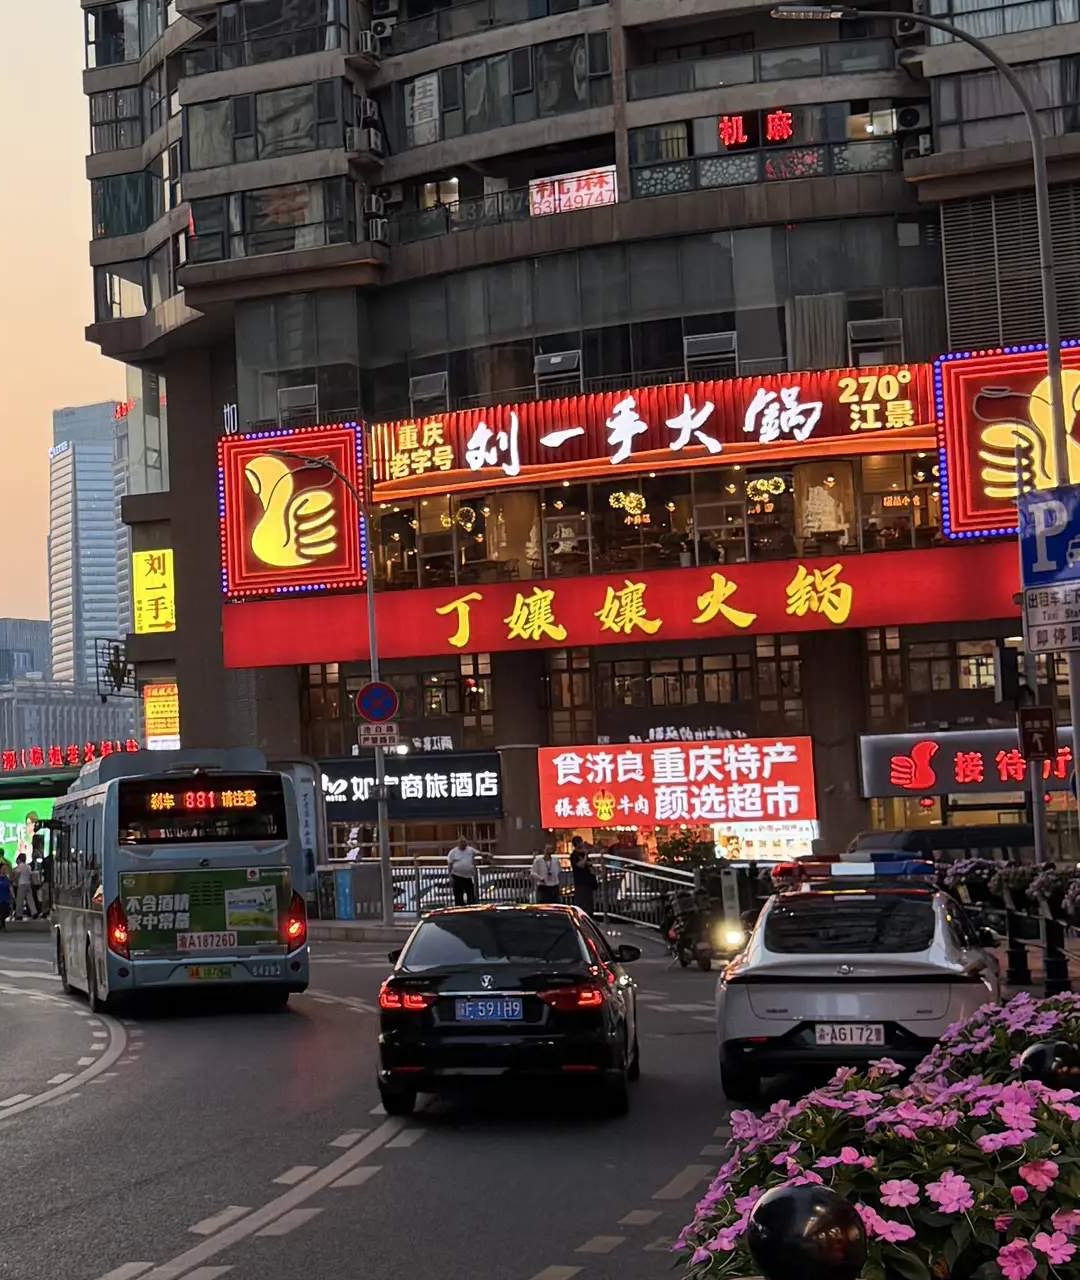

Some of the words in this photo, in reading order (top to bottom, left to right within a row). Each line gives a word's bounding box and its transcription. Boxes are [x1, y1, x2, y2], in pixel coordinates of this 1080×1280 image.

[719, 110, 793, 146] 机麻
[849, 400, 915, 431] 江景
[398, 421, 445, 451] 重庆
[390, 445, 455, 479] 老字号
[1028, 499, 1068, 573] P
[144, 552, 169, 621] 刘一手
[651, 742, 798, 784] 重庆特产
[953, 746, 1073, 783] 接待厅
[185, 791, 215, 809] 881
[222, 789, 257, 808] 请注意
[616, 795, 650, 816] 牛肉
[654, 780, 800, 820] 颜选超市
[126, 893, 190, 913] 不含酒精
[126, 912, 191, 932] 家中常备
[178, 932, 236, 950] 渝A18726D
